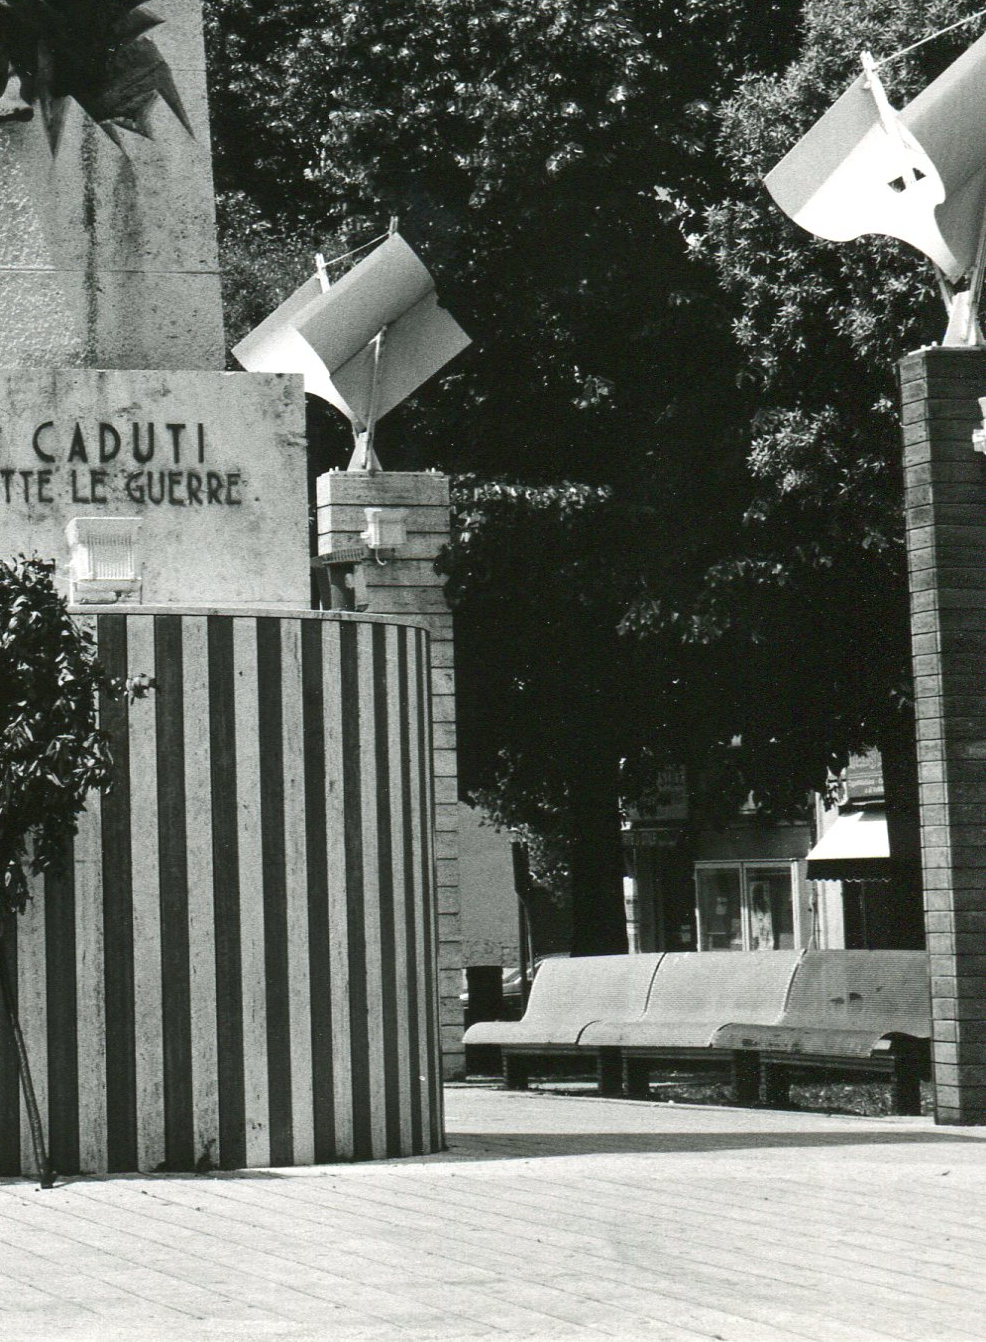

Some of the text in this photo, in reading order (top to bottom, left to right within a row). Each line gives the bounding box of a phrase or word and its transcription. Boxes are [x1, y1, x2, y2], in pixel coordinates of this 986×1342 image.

[31, 420, 205, 464] CADUTI
[71, 469, 109, 504] LE
[124, 469, 242, 506] GUERRE
